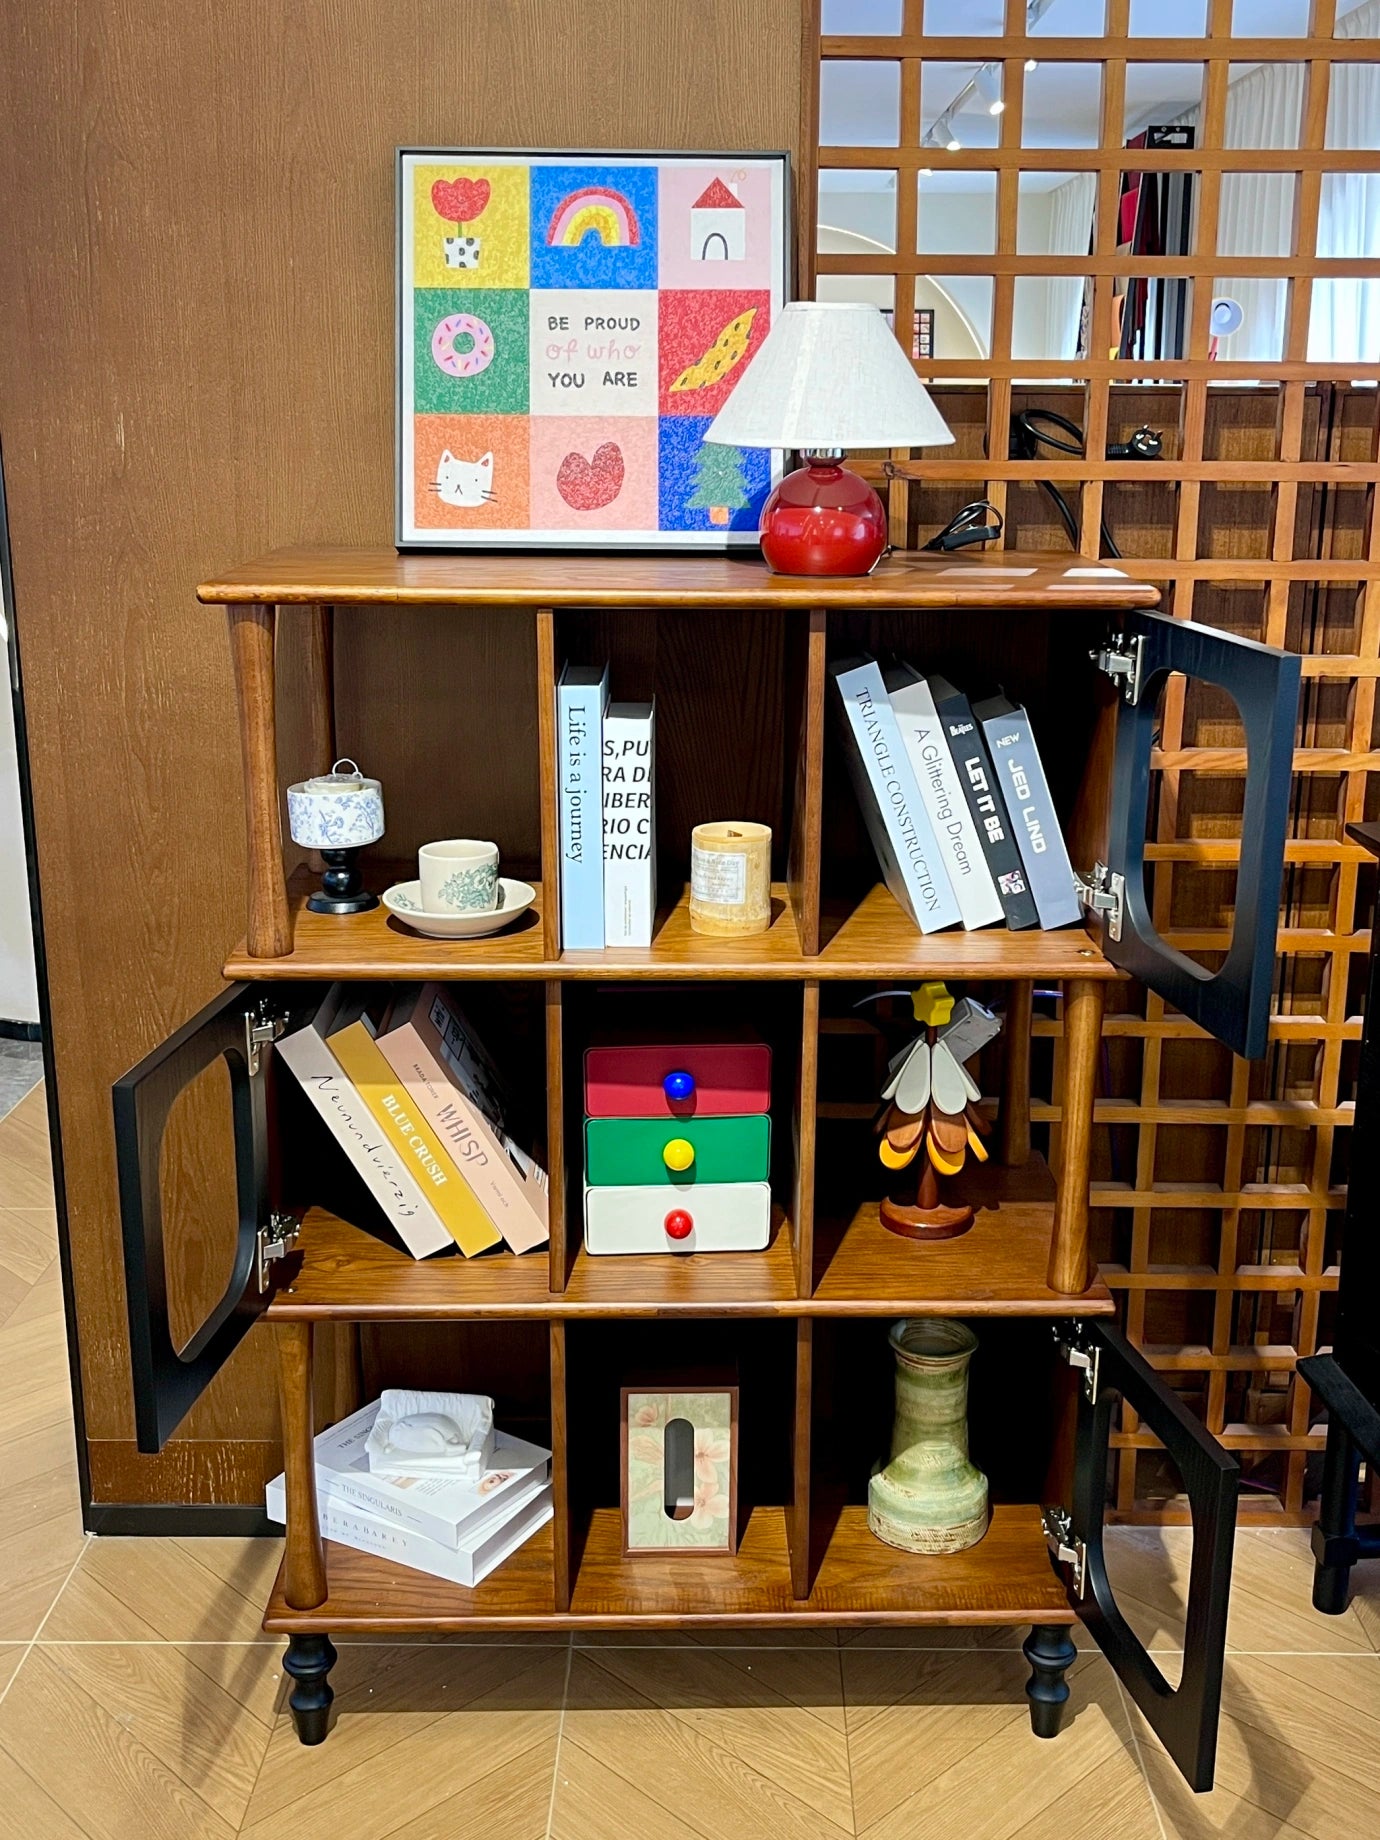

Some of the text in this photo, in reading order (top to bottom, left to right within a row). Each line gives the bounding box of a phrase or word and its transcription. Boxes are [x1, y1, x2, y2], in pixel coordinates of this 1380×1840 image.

[545, 338, 641, 362] of who
[547, 316, 640, 331] BE PROUD
[547, 371, 638, 388] YOU ARE
[996, 732, 1020, 748] NEW
[565, 705, 588, 864] Life is a journey
[855, 686, 941, 912] TRIANGLE CONSTRUCTION
[914, 729, 972, 876] A Glittering Dream
[965, 756, 1005, 844] LET IT BE
[1008, 759, 1047, 854] JED LIND
[382, 1093, 448, 1186] BLUE CRUSH
[436, 1103, 489, 1167] WHISP
